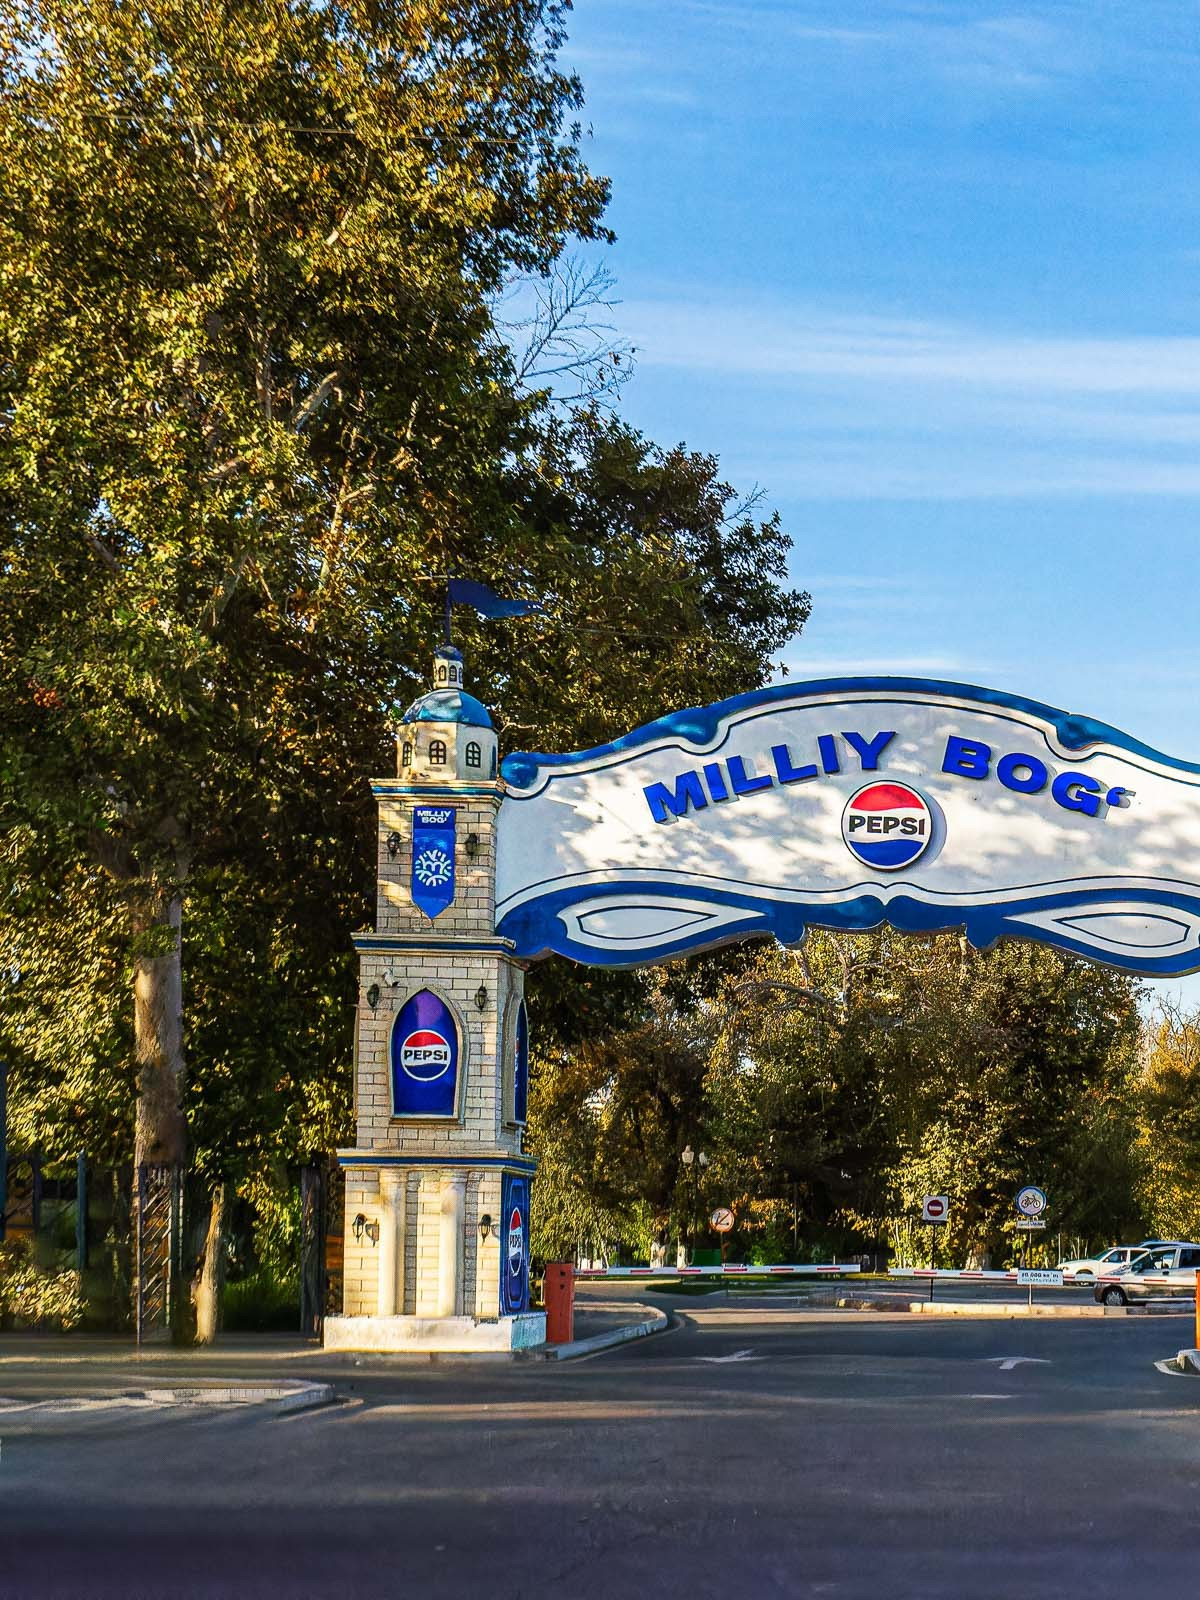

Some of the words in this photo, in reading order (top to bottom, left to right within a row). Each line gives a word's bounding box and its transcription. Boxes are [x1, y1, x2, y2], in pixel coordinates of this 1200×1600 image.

[643, 731, 897, 823] MILLIY
[849, 815, 925, 836] PEPSI
[403, 1049, 448, 1061] PEPSI
